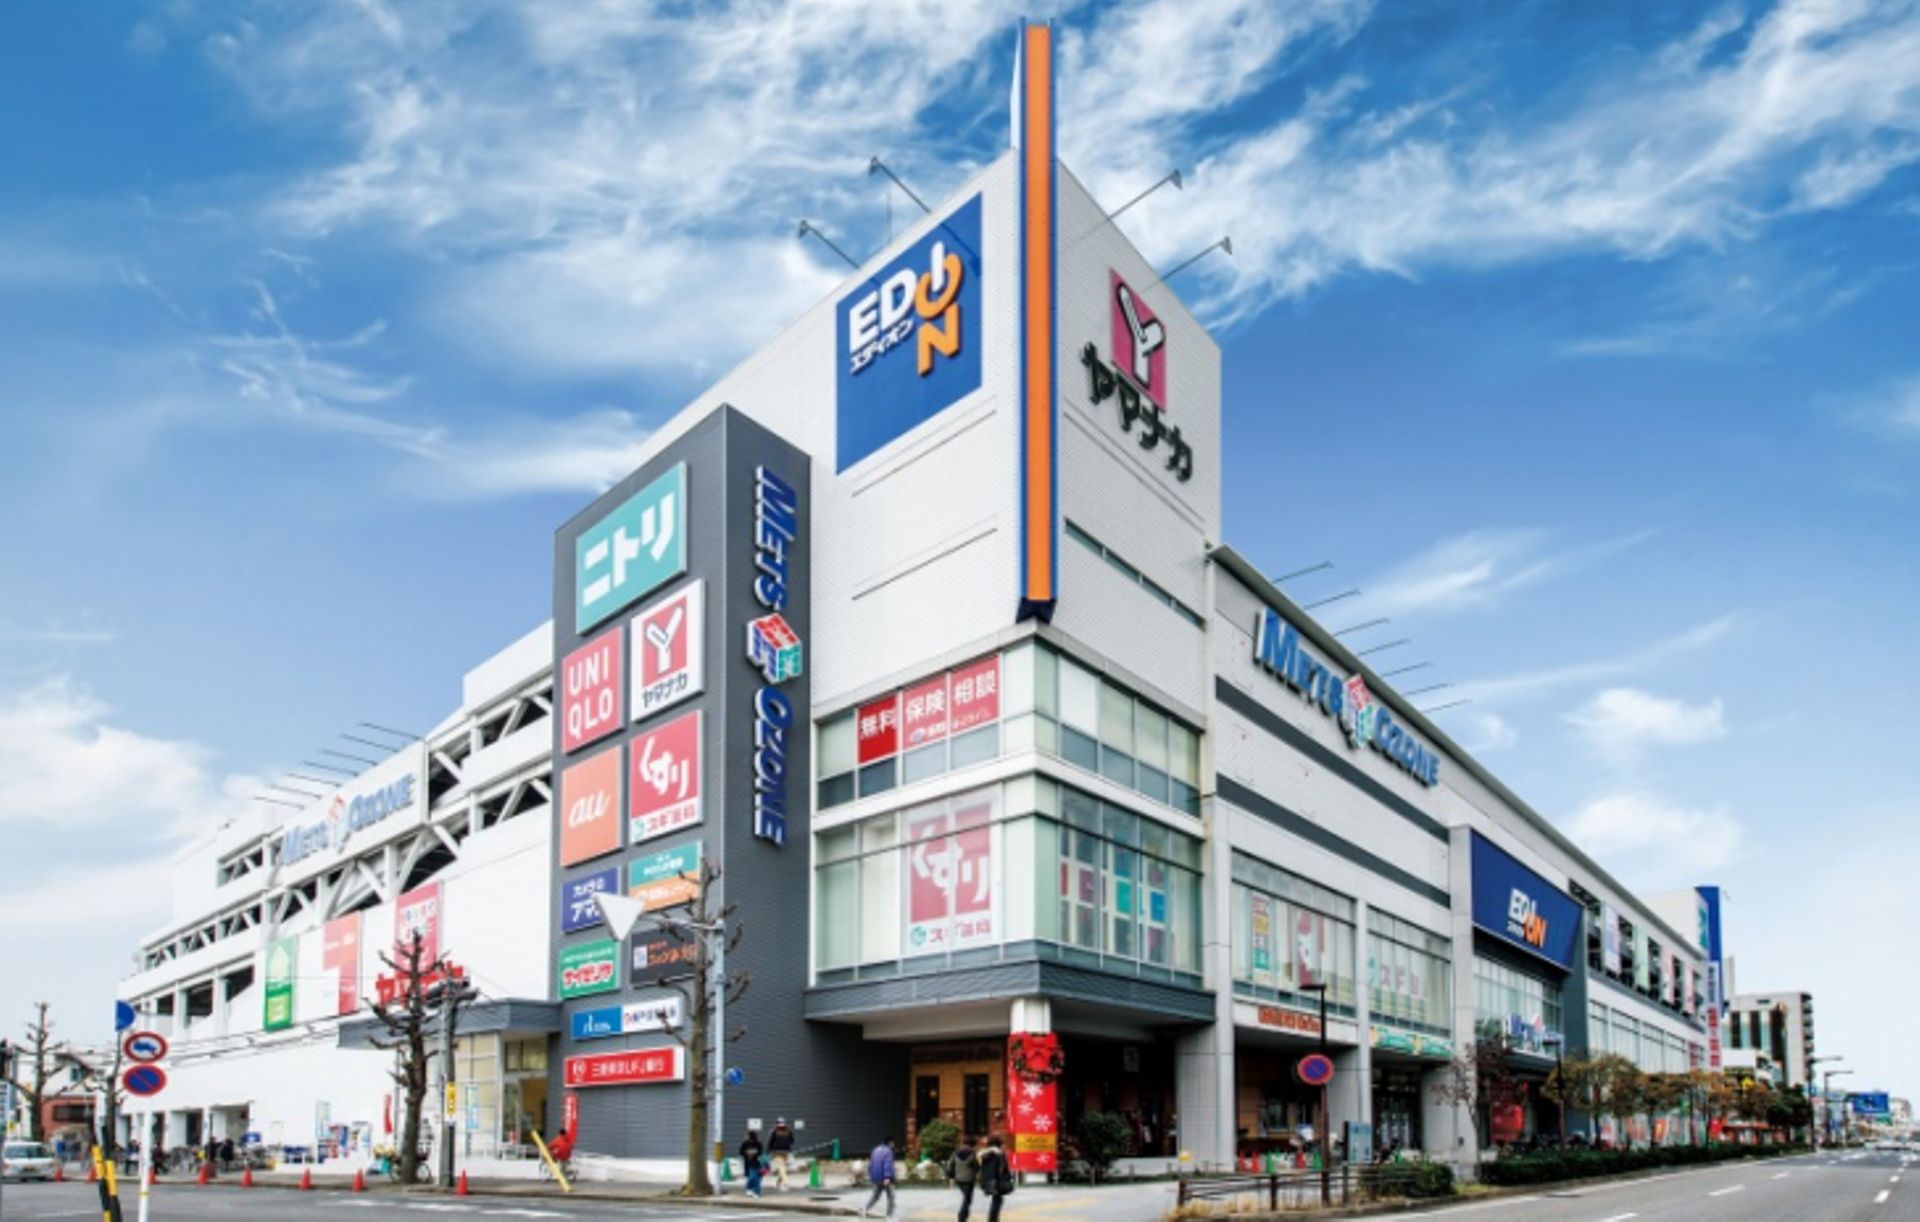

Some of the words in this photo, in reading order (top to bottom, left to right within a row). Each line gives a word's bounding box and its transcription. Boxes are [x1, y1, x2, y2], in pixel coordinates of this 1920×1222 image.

[1080, 340, 1193, 483] ヤマナカ
[583, 492, 675, 607] ニトリ
[569, 646, 610, 696] UNI
[642, 673, 688, 708] ヤマナカ
[905, 689, 946, 723] 保険
[954, 670, 997, 706] 相談
[567, 687, 614, 740] QLO
[639, 736, 689, 800] くすり
[569, 790, 611, 828] au
